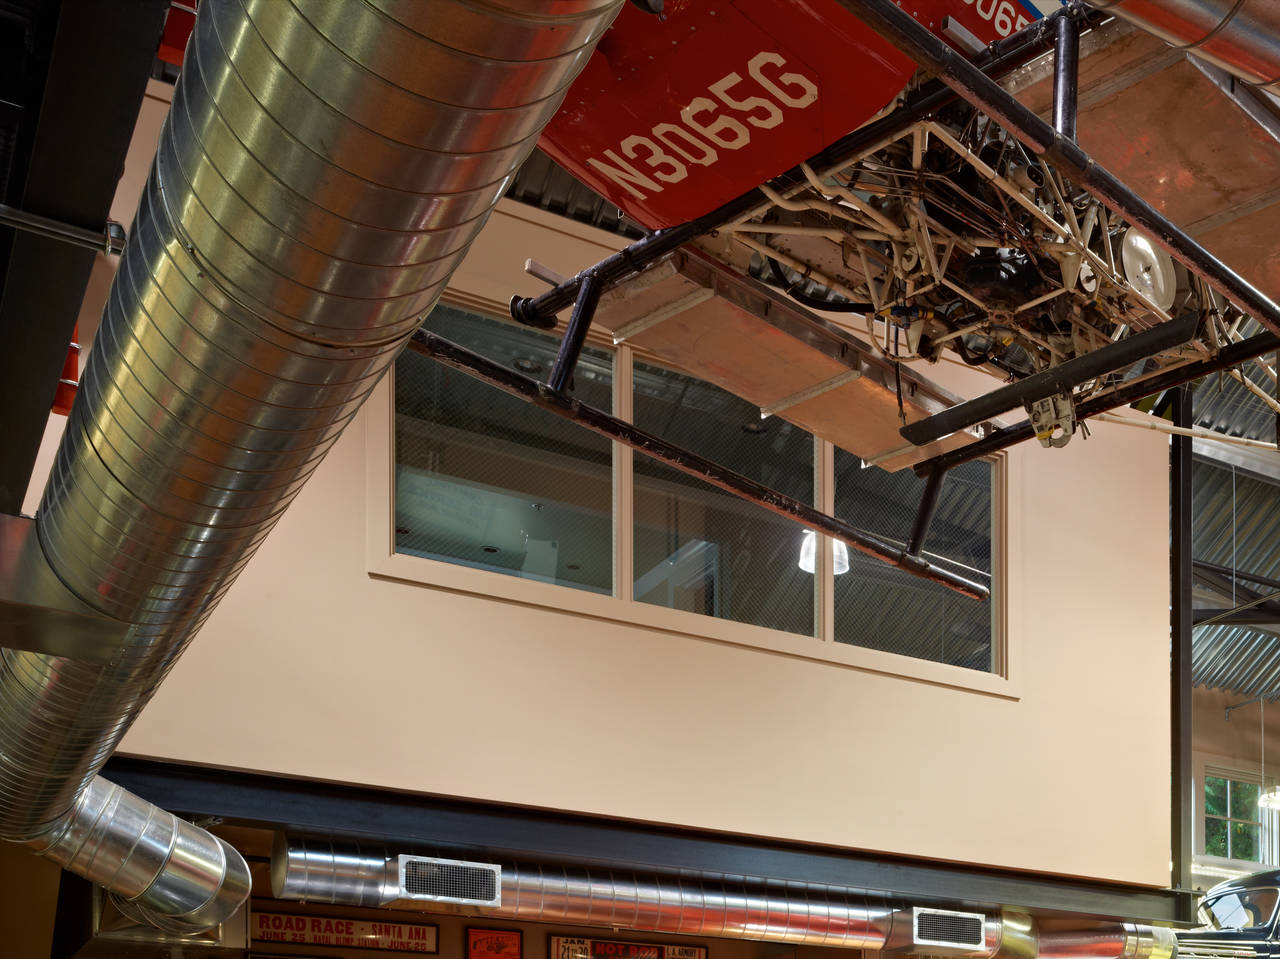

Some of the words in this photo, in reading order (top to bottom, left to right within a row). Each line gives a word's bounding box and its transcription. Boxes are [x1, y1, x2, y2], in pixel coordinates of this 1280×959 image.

[586, 51, 818, 201] N3065G
[259, 914, 306, 931] ROAD
[311, 918, 354, 935] RACE
[371, 923, 402, 939] SANTA
[407, 926, 427, 941] ANA
[595, 943, 625, 956] HOT
